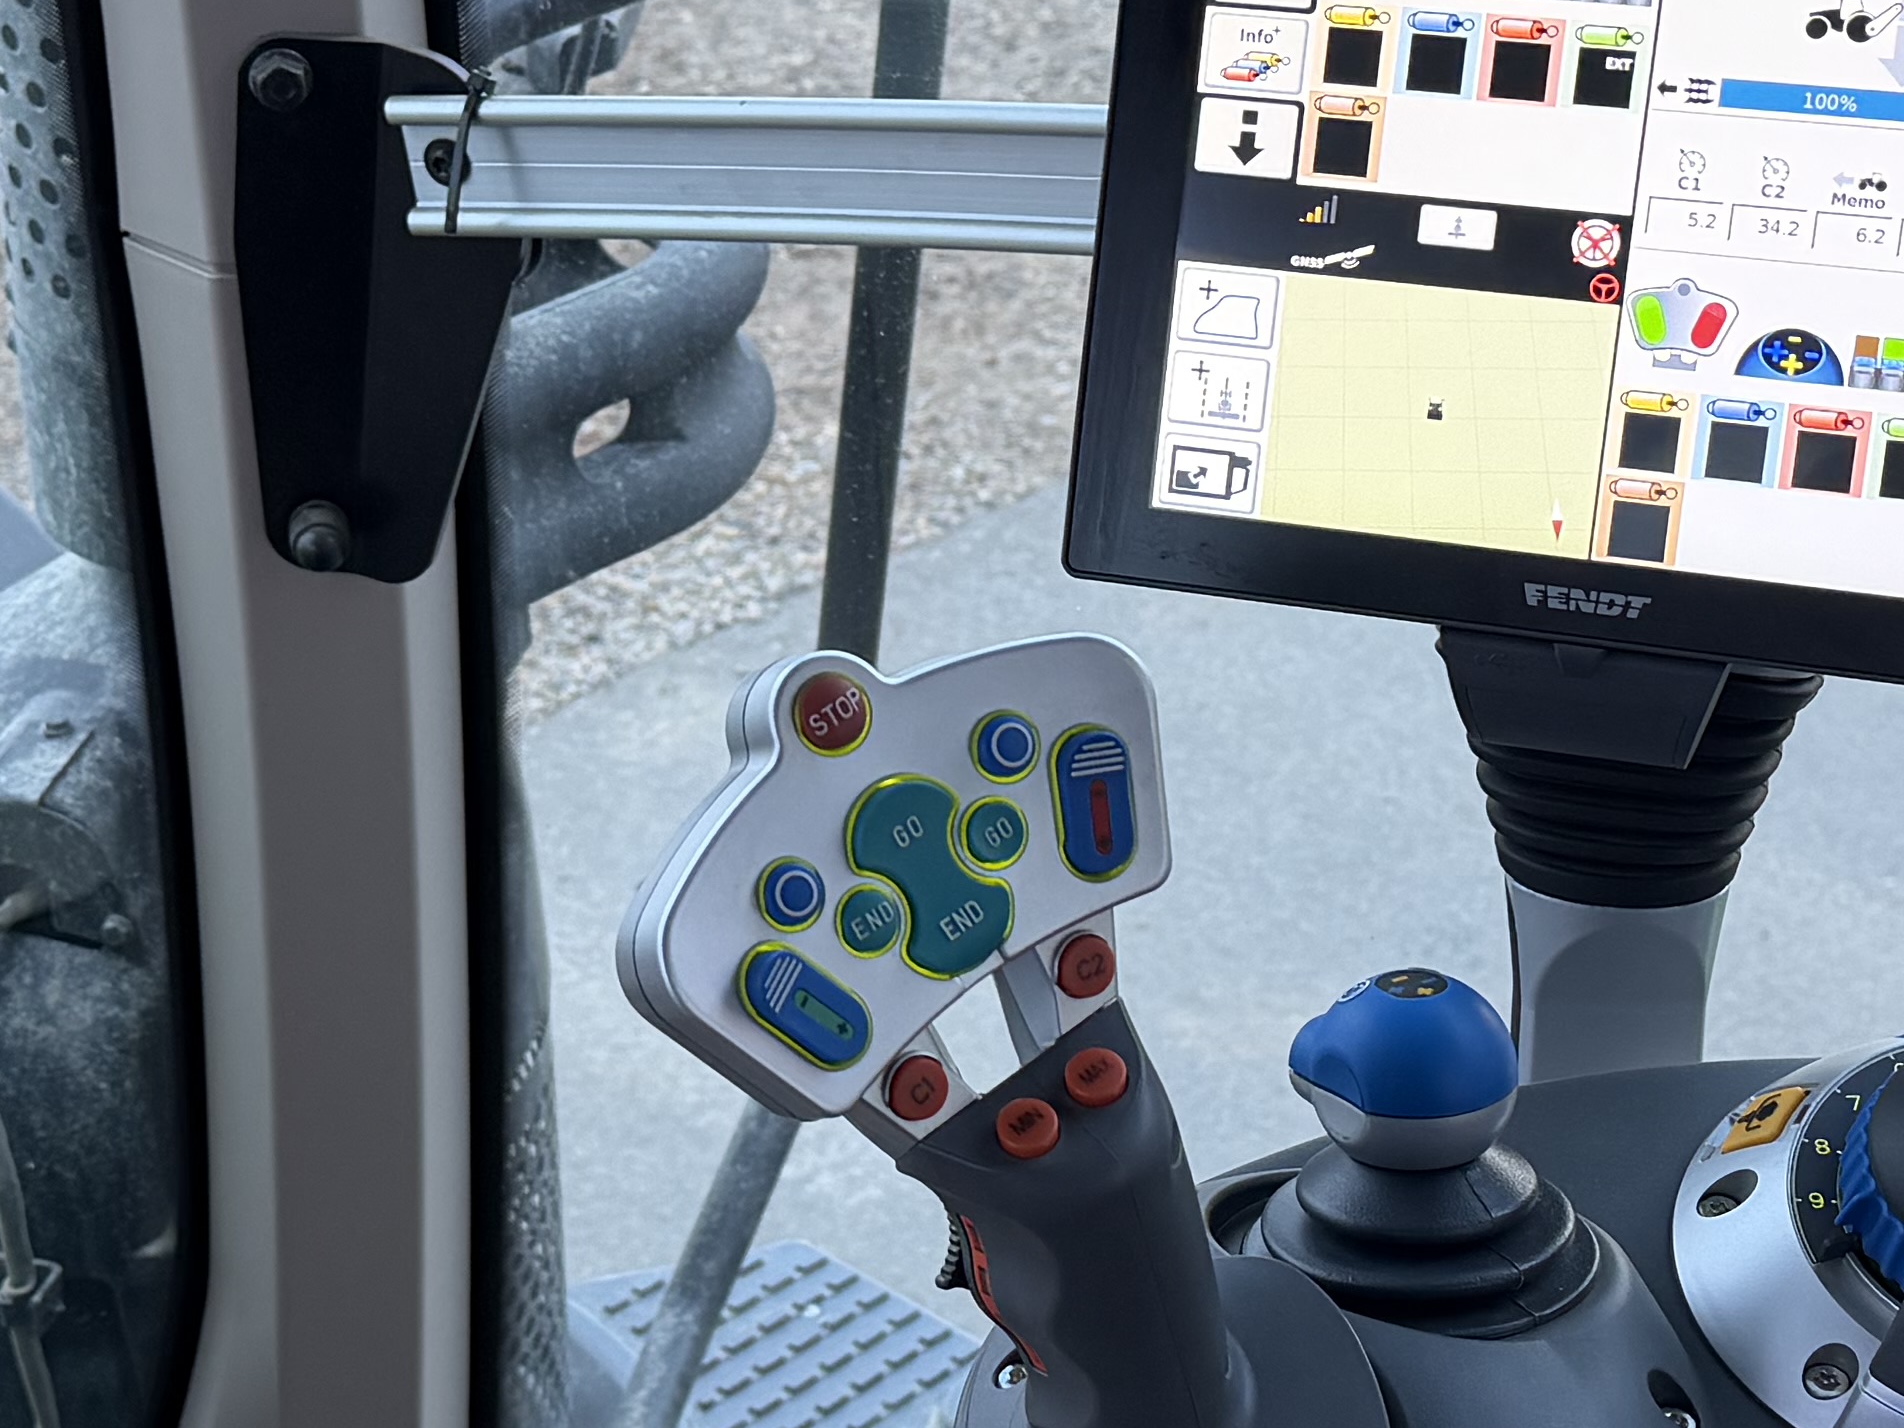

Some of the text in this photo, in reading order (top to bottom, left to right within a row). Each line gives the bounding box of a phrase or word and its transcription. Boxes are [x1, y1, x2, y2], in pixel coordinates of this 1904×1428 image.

[1803, 91, 1858, 113] 100%
[1678, 175, 1702, 192] C1
[1761, 183, 1786, 199] C2
[1831, 192, 1886, 210] Memo
[1688, 212, 1717, 229] 5.2
[1758, 218, 1800, 237] 34.2
[1856, 228, 1886, 245] 6.2
[1523, 582, 1652, 619] FENDT
[808, 686, 861, 737] STOP
[892, 815, 924, 848] GO
[984, 816, 1014, 848] GO
[851, 900, 895, 941] END
[939, 899, 985, 941] END
[1076, 952, 1105, 981] C2
[1078, 1058, 1110, 1085] MAX
[910, 1076, 936, 1105] C1
[1845, 1095, 1861, 1111] 7
[1008, 1107, 1044, 1136] MIN
[1814, 1138, 1831, 1155] 8
[1808, 1192, 1825, 1209] 9
